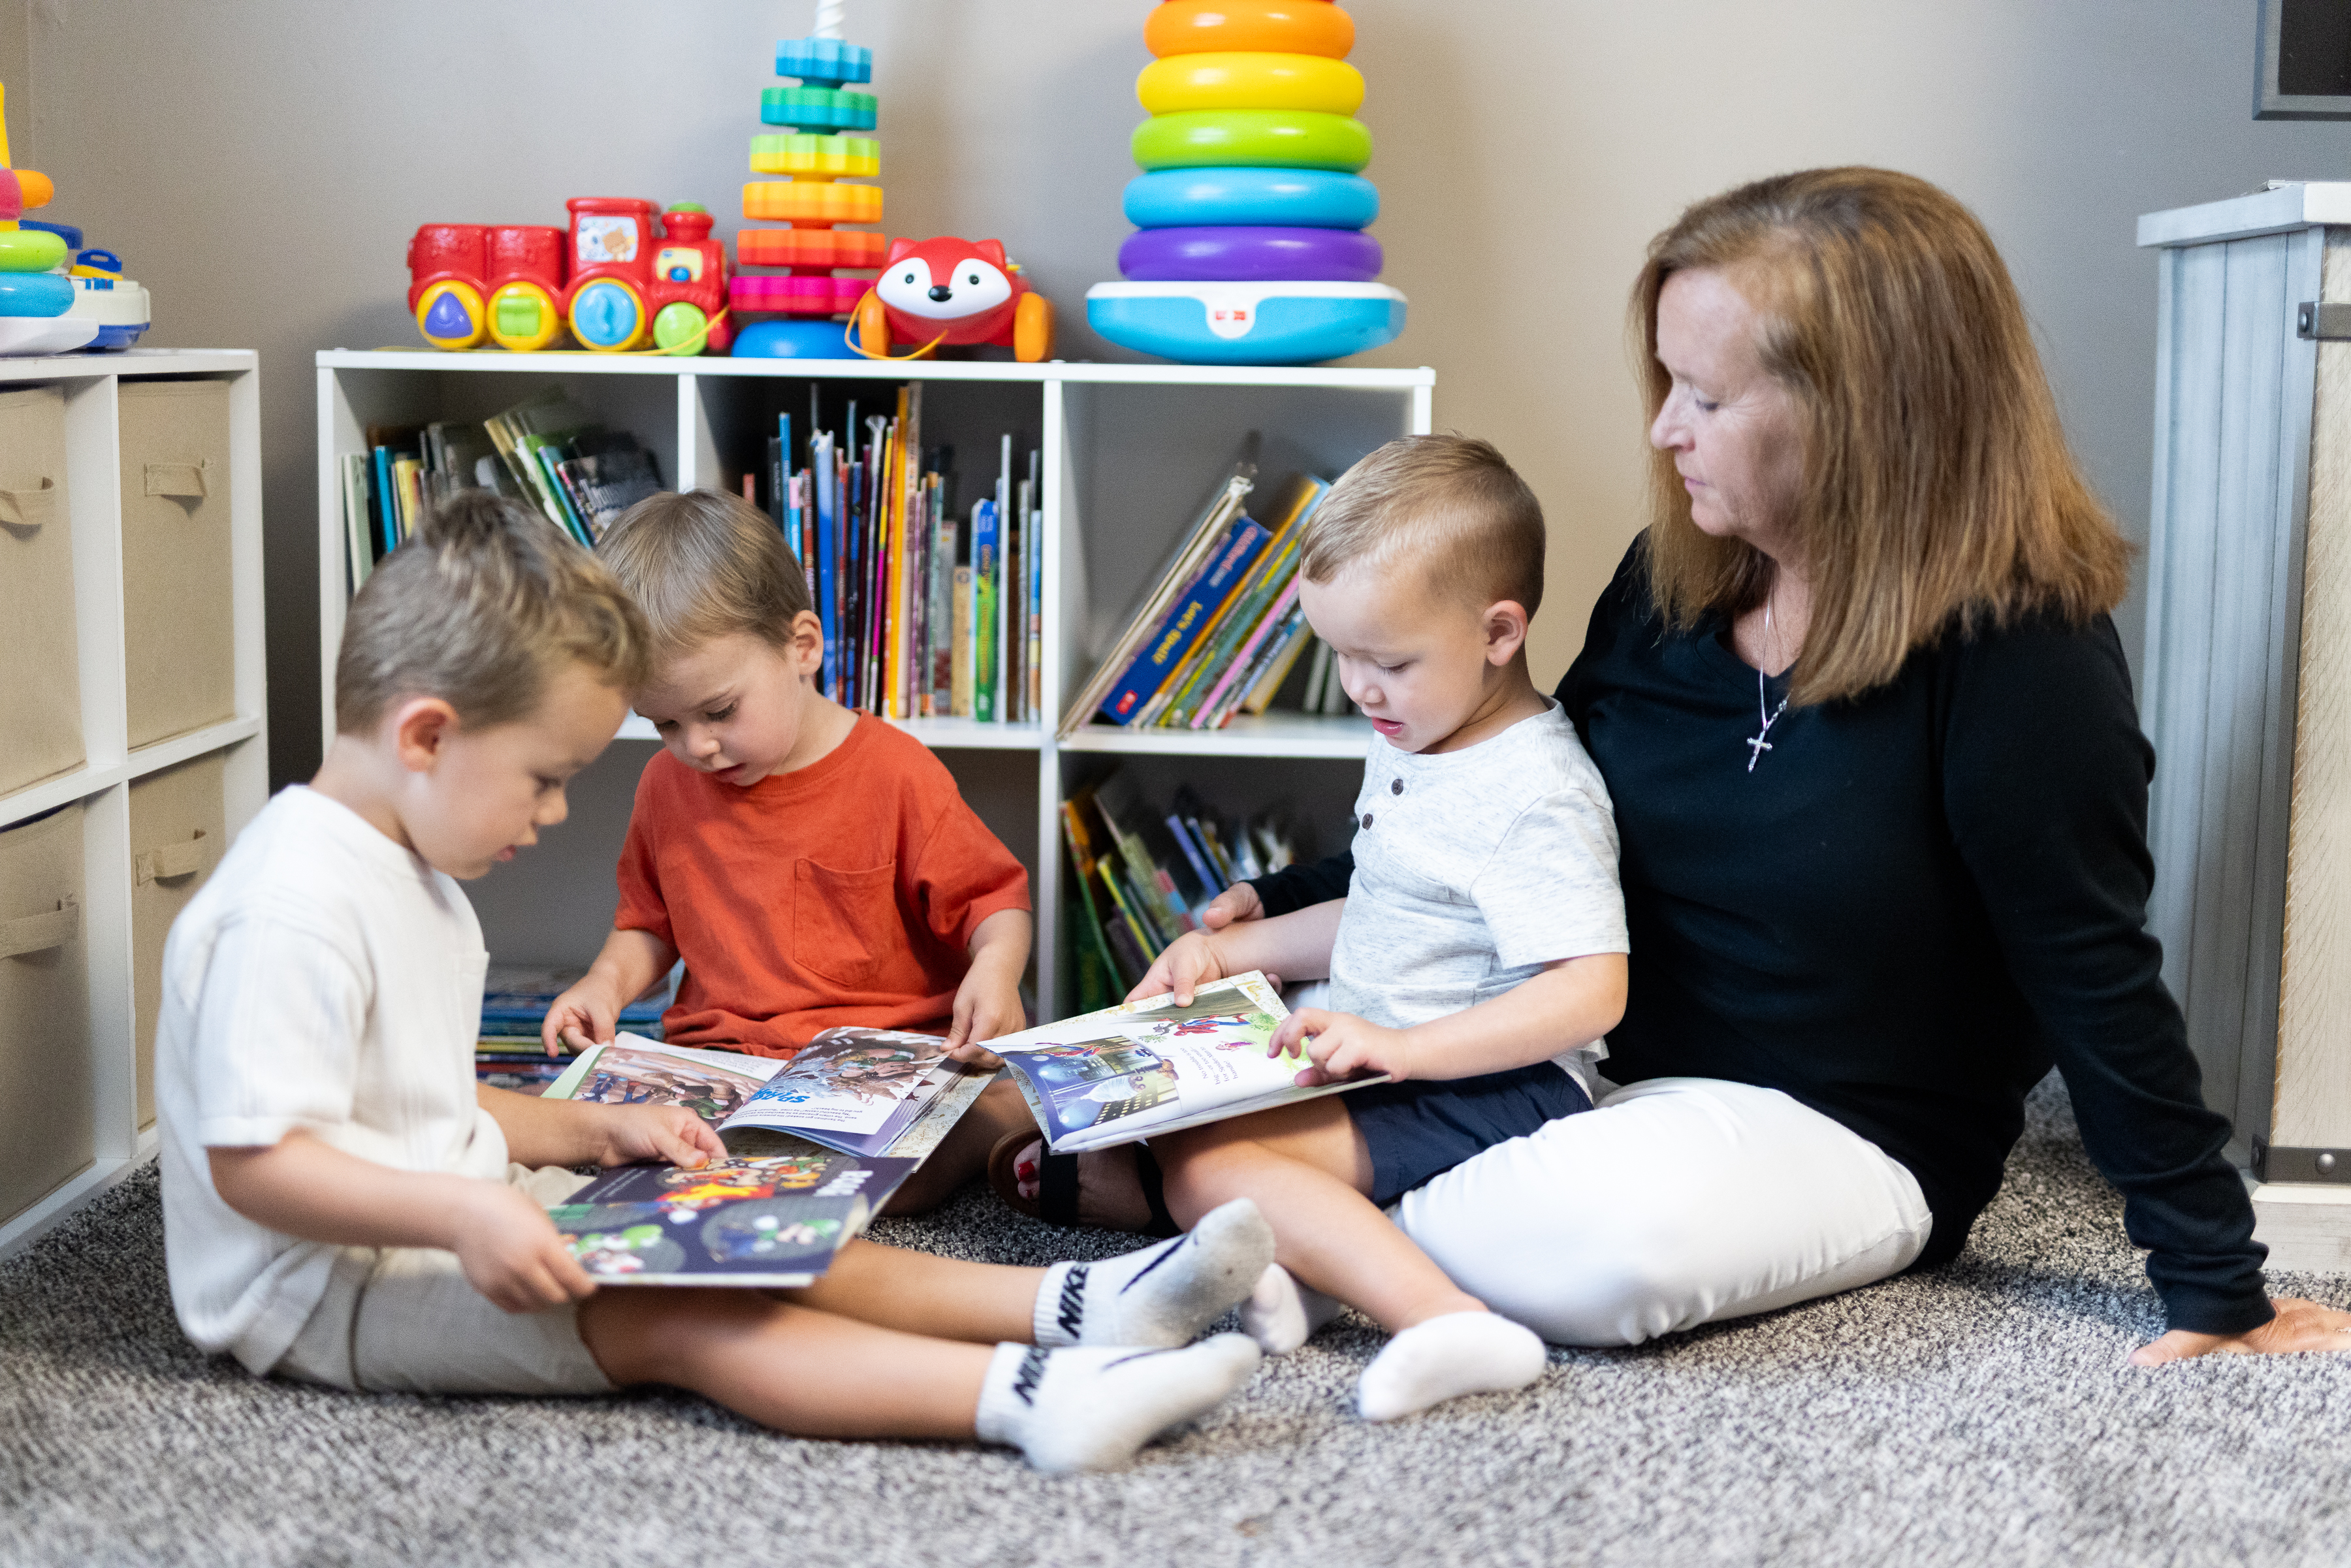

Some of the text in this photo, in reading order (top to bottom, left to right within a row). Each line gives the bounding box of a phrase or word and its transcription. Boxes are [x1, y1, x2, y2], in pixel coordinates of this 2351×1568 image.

[1190, 1056, 1204, 1070] trouble
[1202, 1070, 1209, 1079] No
[1057, 1264, 1090, 1339] NIKE
[1013, 1345, 1051, 1406] NIK
